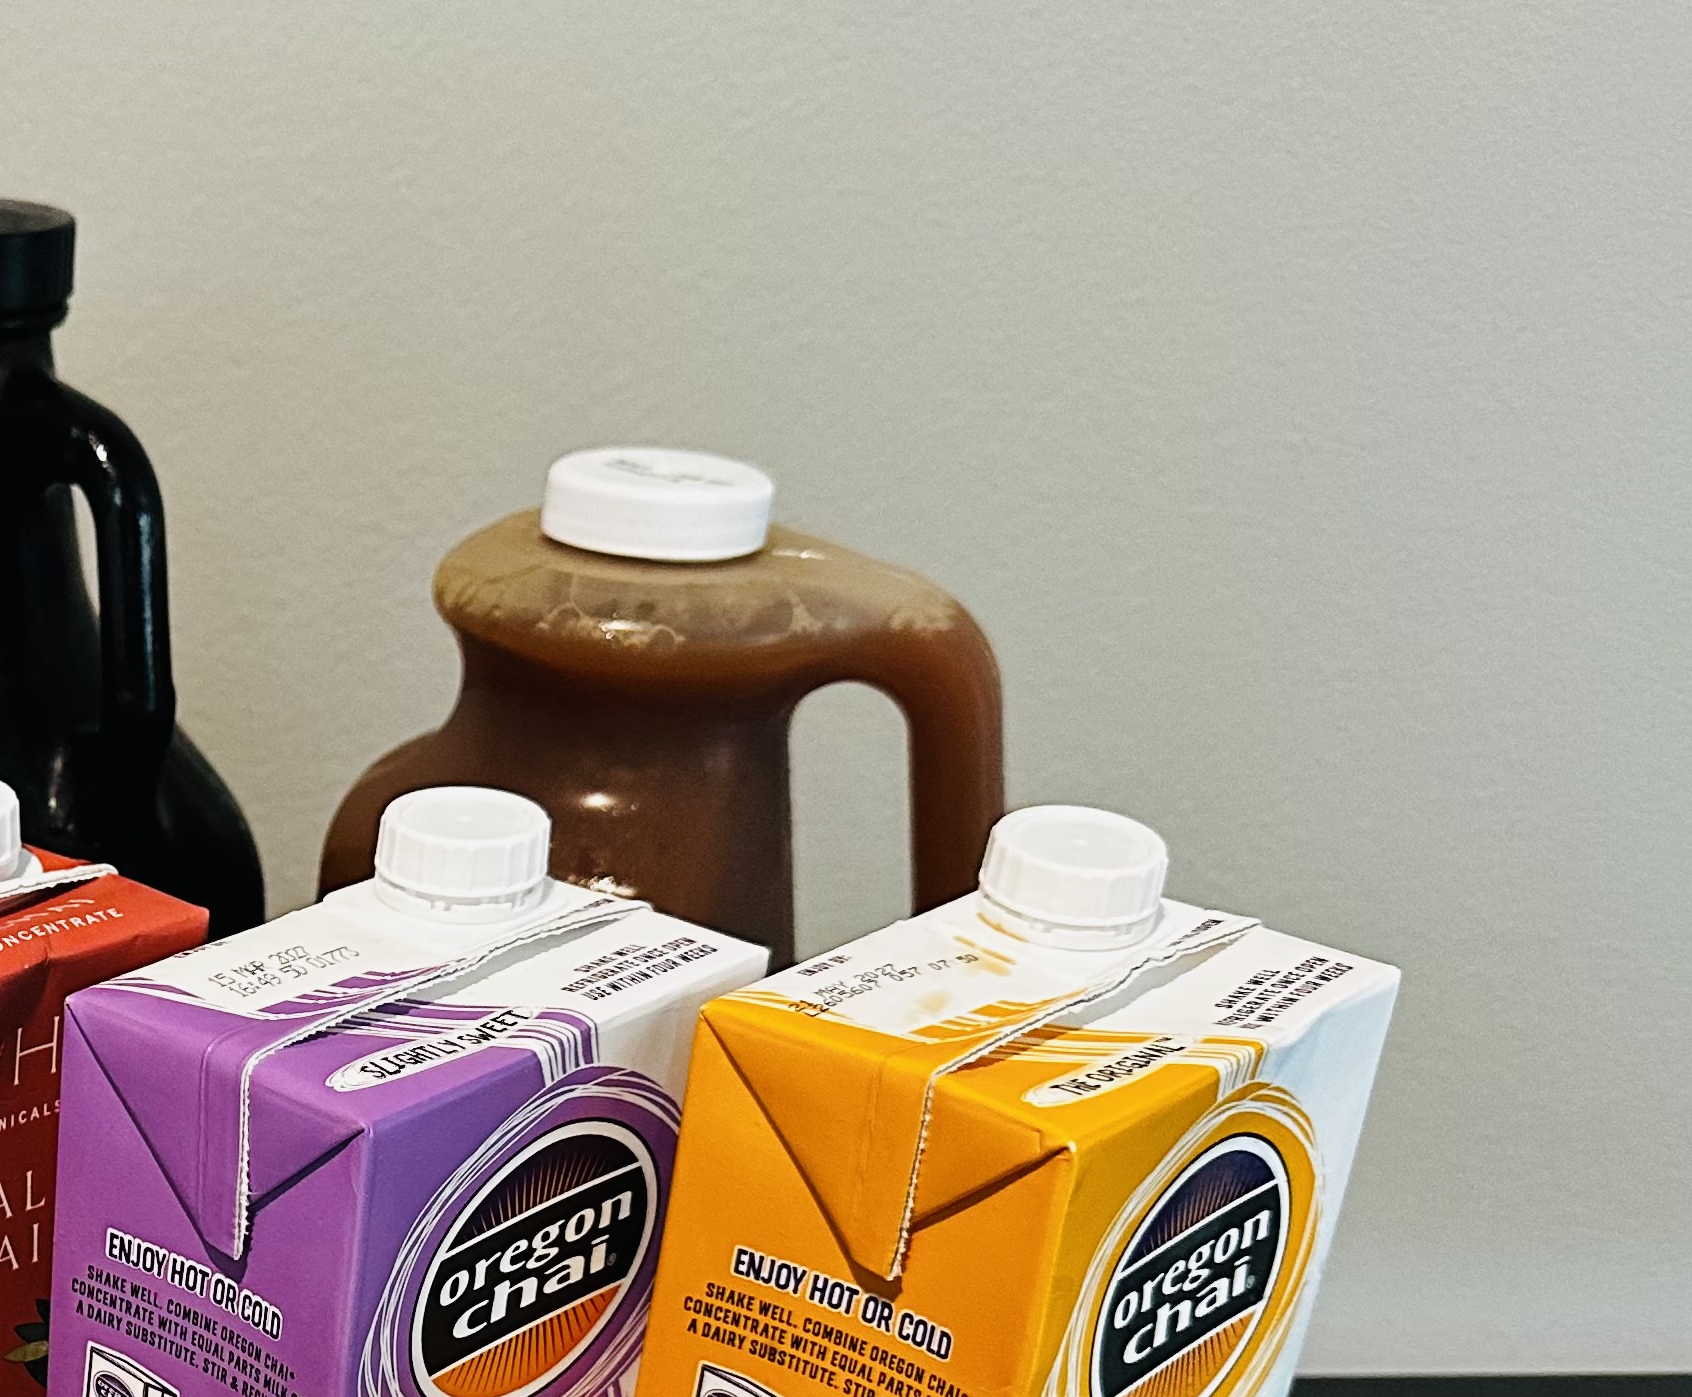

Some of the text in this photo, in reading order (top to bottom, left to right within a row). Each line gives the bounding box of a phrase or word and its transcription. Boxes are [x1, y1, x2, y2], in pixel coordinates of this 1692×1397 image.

[361, 1009, 531, 1080] SLIGHTLY SWEET
[1049, 1076, 1101, 1096] THE
[108, 1231, 281, 1340] ENJOY HOT OR COLD
[440, 1189, 633, 1307] oregon
[452, 1234, 610, 1339] chai
[1114, 1209, 1273, 1330] oregon
[683, 1296, 785, 1345] CONCENTRATE
[790, 1327, 827, 1361] WITH
[830, 1350, 873, 1388] EQUAL
[687, 1318, 697, 1334] A
[701, 1321, 748, 1351] DAIRY
[748, 1339, 840, 1390] SUBSTITUTE.
[705, 1282, 755, 1311] SHAKE
[803, 1317, 868, 1356] COMBINE
[870, 1345, 925, 1384] OREGON
[734, 1249, 952, 1360] ENJOY HOT OR COLD
[1122, 1256, 1250, 1365] chai
